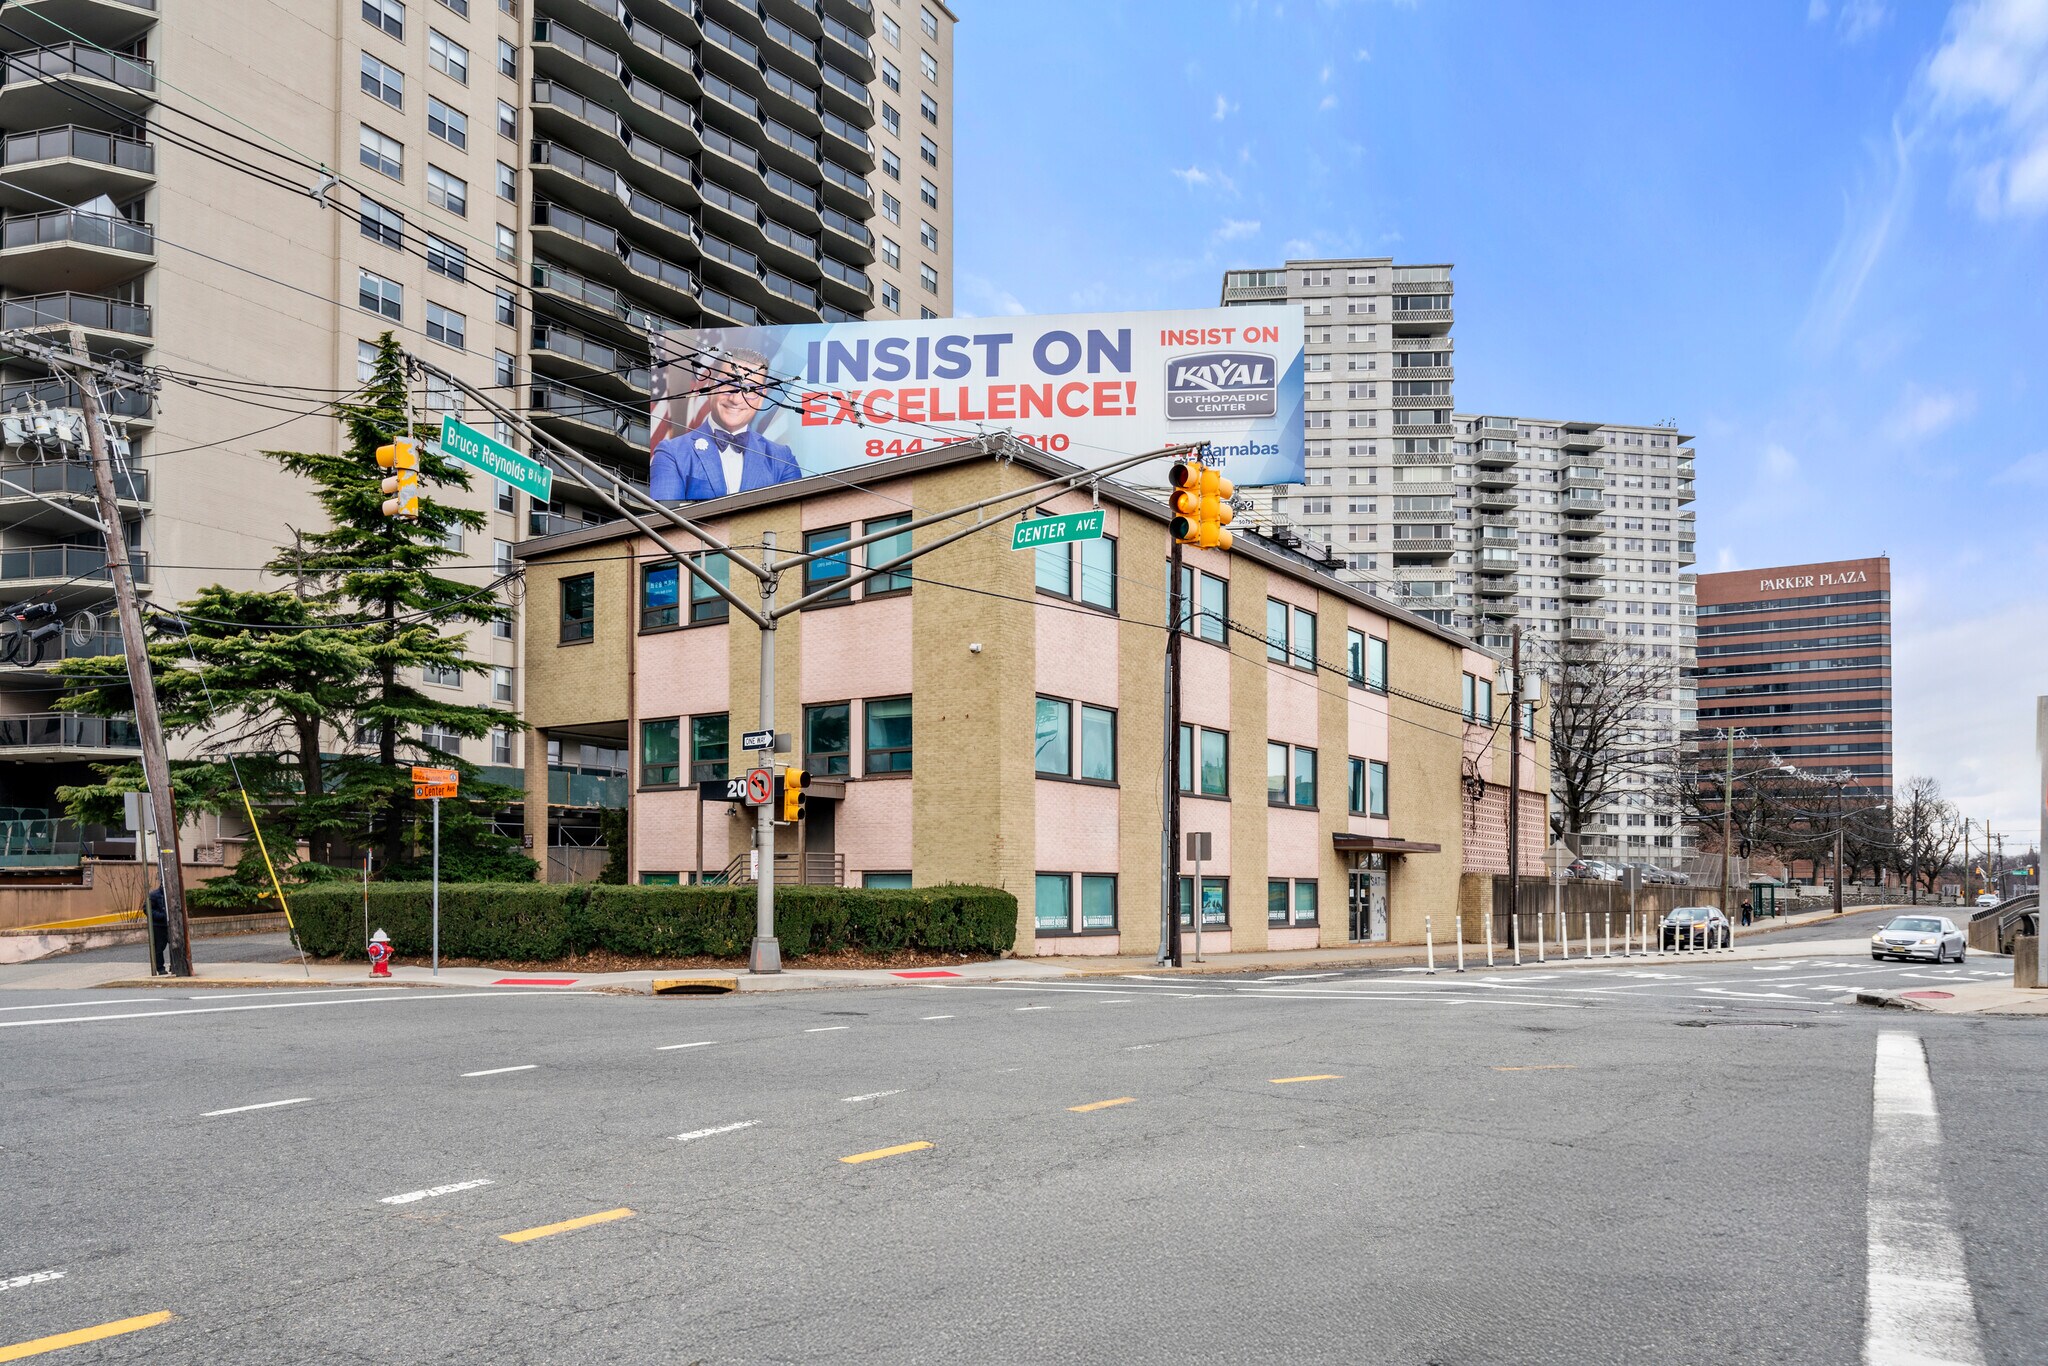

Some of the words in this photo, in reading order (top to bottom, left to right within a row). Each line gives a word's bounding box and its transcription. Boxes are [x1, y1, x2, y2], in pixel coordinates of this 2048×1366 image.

[1160, 328, 1236, 346] INSIST
[1243, 326, 1279, 344] ON
[806, 332, 1014, 384] INSIST
[1032, 329, 1132, 376] ON
[1174, 360, 1269, 391] KAYAL
[801, 381, 1137, 426] EXCELLENCE!
[1174, 393, 1269, 404] ORTHOPAEDIC
[1196, 403, 1246, 412] CENTER
[447, 426, 479, 458] Bruce
[482, 444, 525, 482] Reynolds
[528, 470, 547, 487] Blvd
[1017, 522, 1066, 544] CENTER
[1075, 518, 1099, 532] AVE.
[1760, 575, 1814, 591] PARKER
[1820, 571, 1867, 586] PLAZA
[745, 737, 756, 746] ONE
[757, 736, 767, 744] WAY
[424, 786, 445, 797] Center
